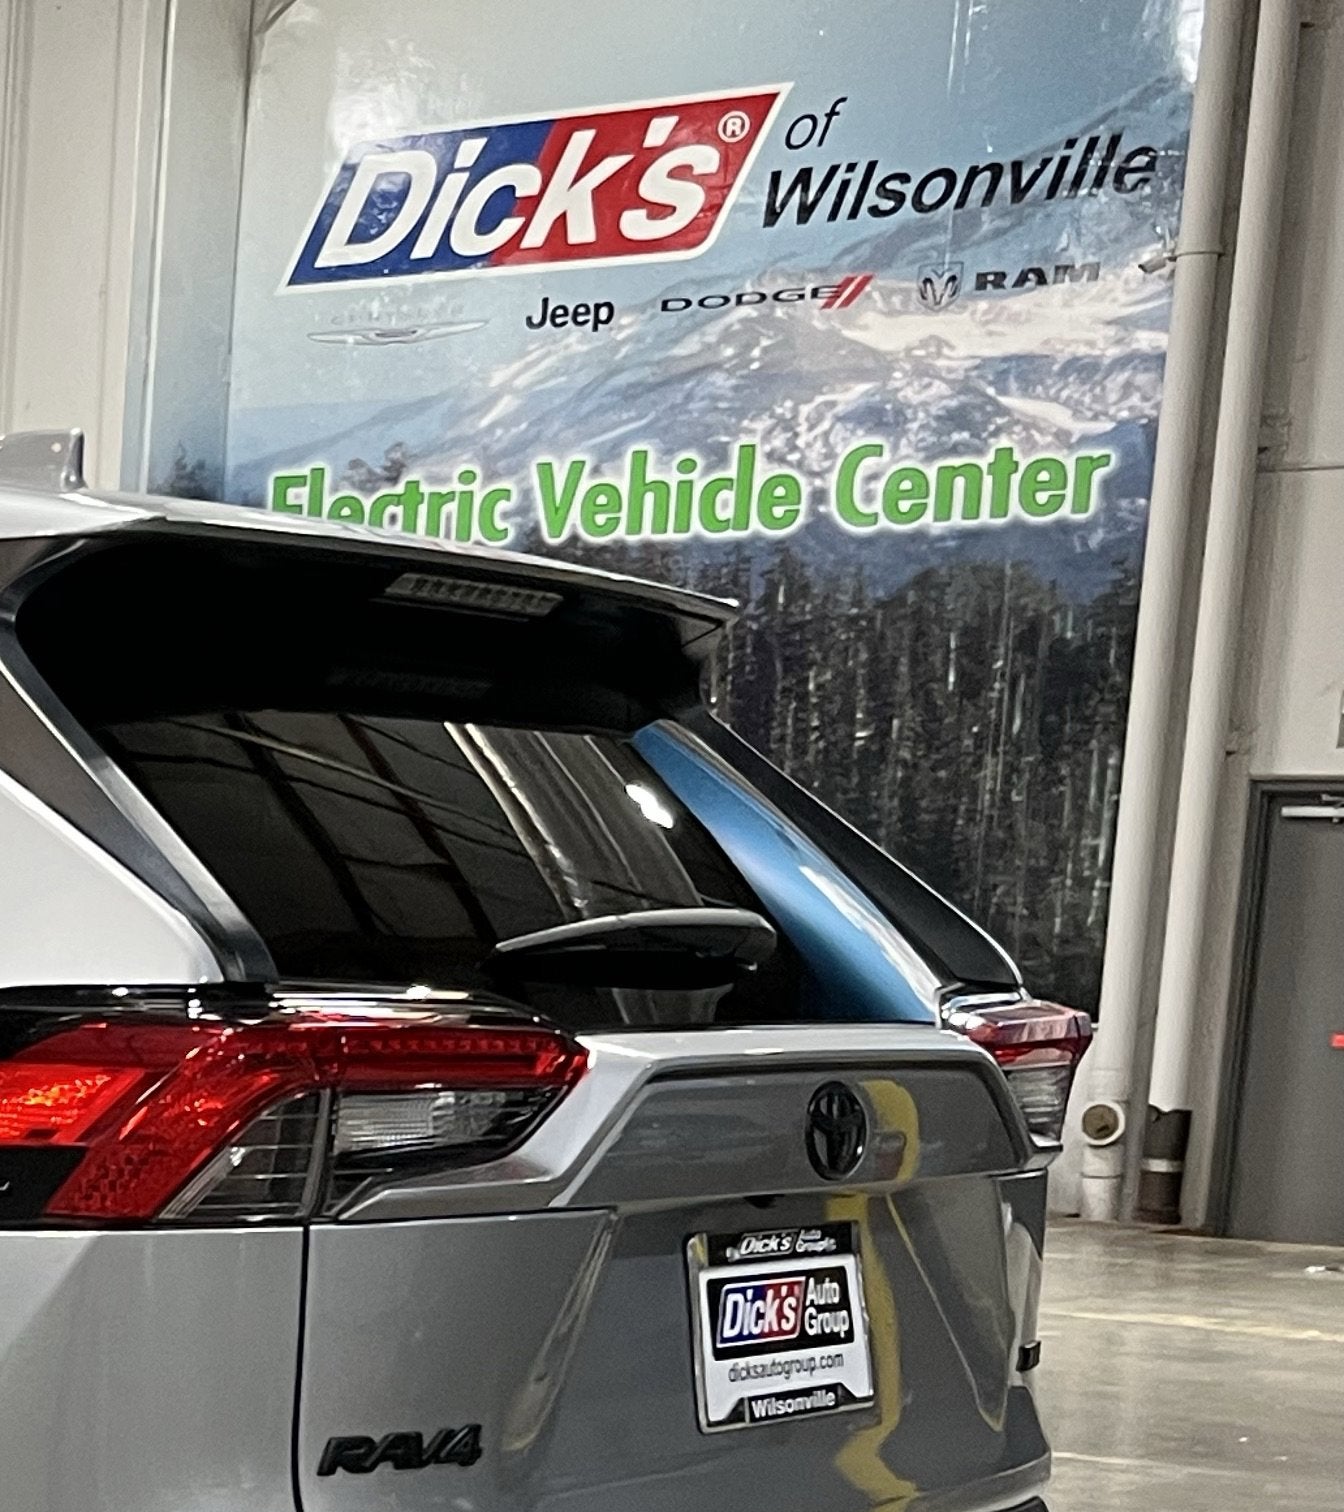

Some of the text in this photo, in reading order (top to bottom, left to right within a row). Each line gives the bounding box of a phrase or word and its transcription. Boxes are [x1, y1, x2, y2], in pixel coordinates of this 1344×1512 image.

[785, 97, 848, 151] of
[762, 128, 1158, 229] Wilsonville
[660, 284, 842, 312] DODGE
[974, 261, 1101, 292] RAM
[525, 296, 614, 333] Jeep
[271, 443, 1112, 542] Electric Vehicle Center
[722, 1277, 840, 1339] Dick's Auto
[804, 1306, 850, 1339] Group
[751, 1389, 836, 1419] Wilsonville
[316, 1423, 483, 1477] RAV4
